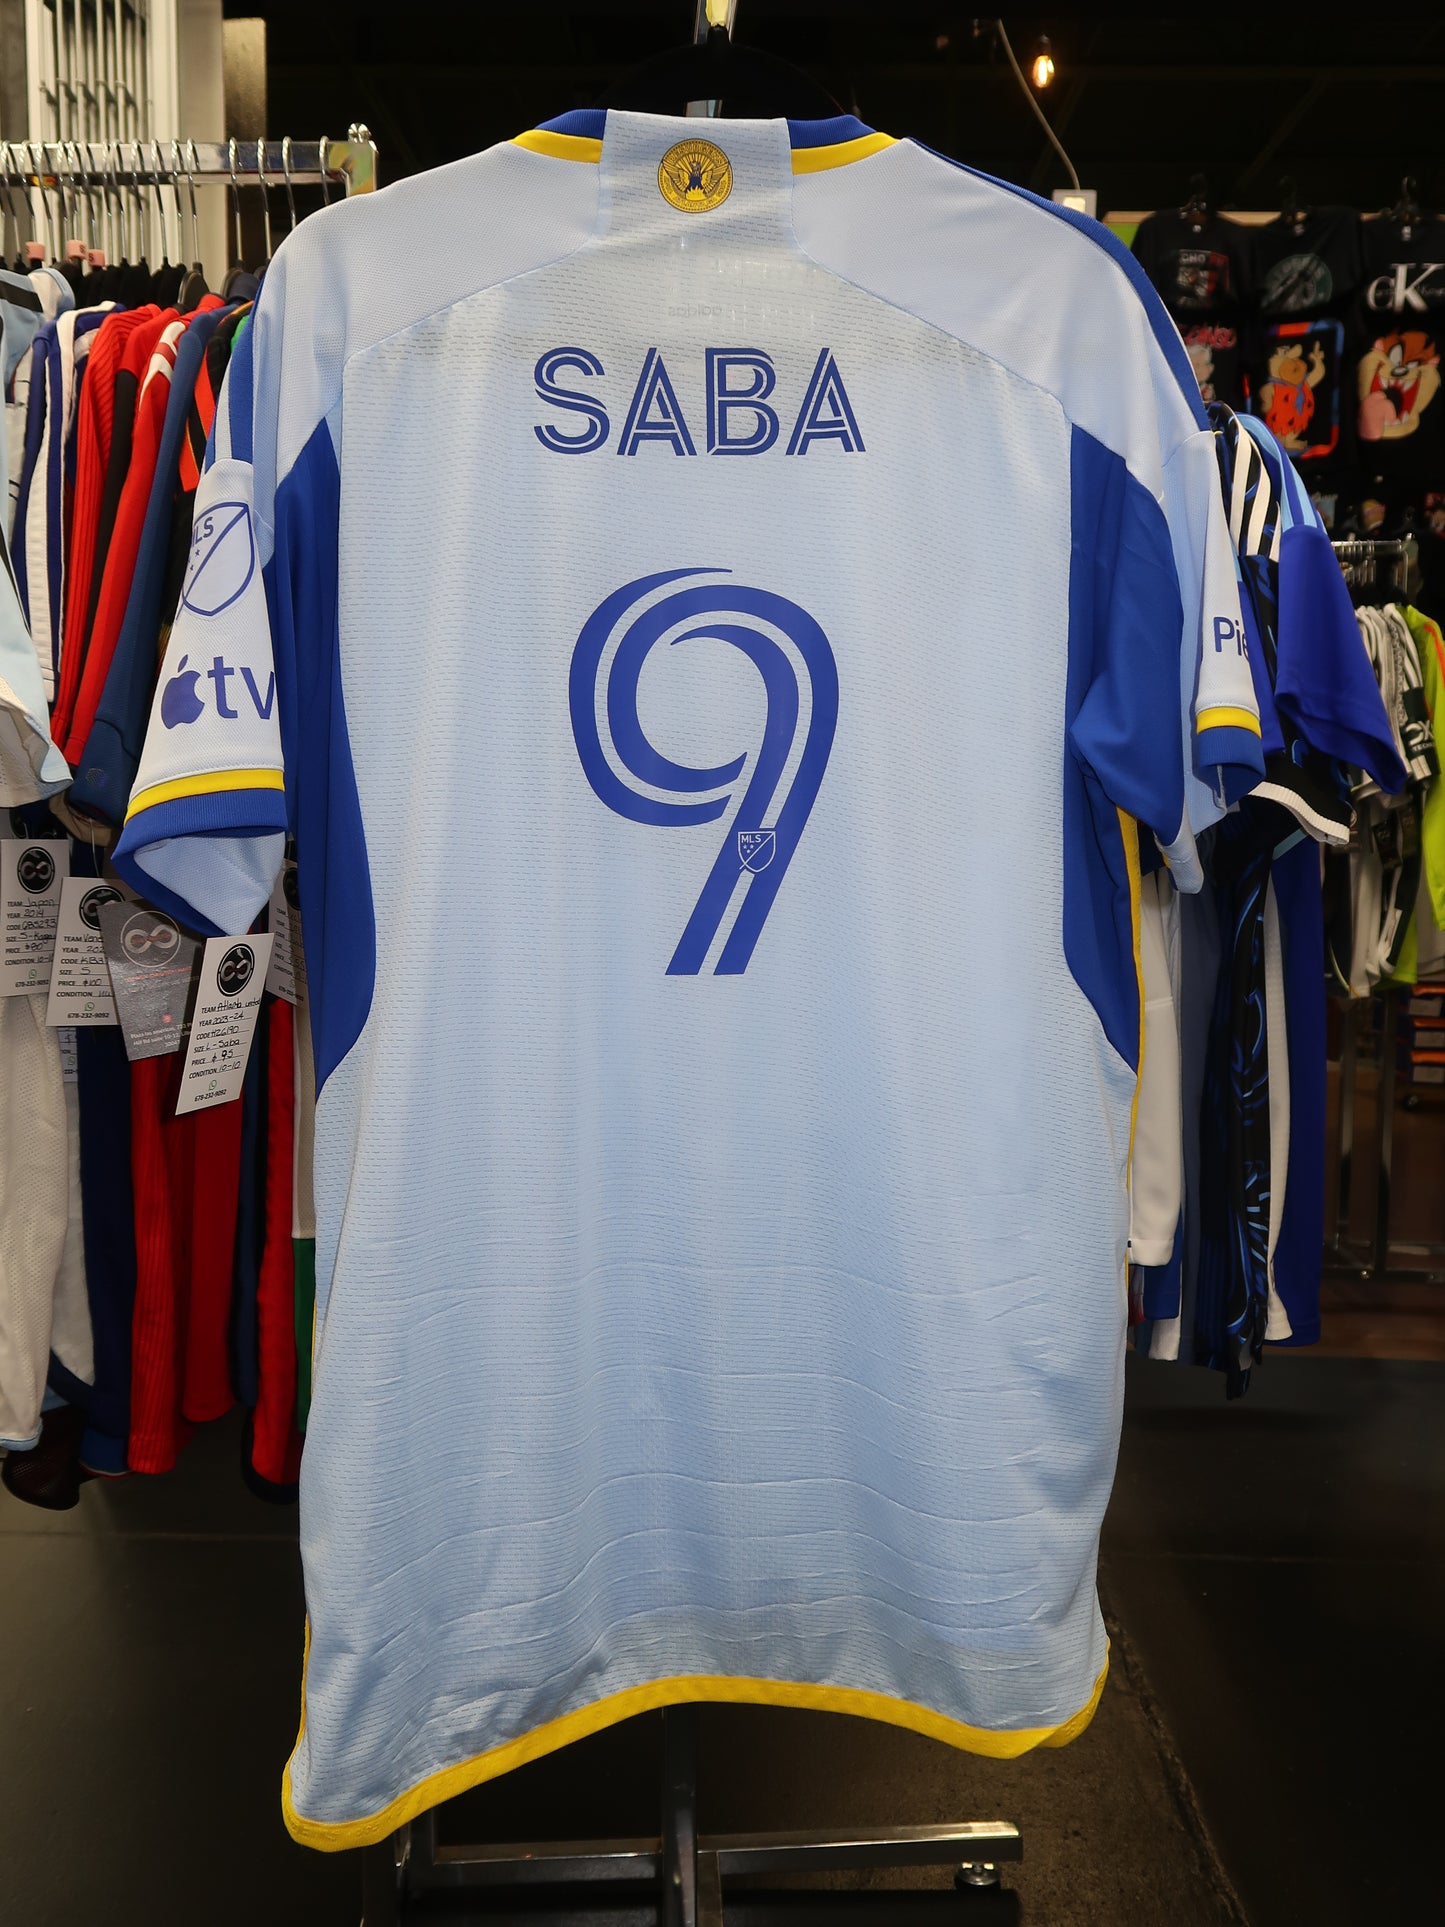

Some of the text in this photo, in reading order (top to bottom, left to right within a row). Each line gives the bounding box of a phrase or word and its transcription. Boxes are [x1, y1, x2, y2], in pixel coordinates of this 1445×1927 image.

[534, 346, 866, 456] SABA
[207, 656, 274, 719] tv
[569, 567, 839, 975] 9
[741, 834, 761, 843] MLS
[201, 1006, 217, 1014] TEAM
[199, 1019, 212, 1027] YEAR
[196, 1031, 211, 1040] CODE
[191, 1058, 206, 1066] PRICE
[189, 1068, 218, 1079] CONDITION
